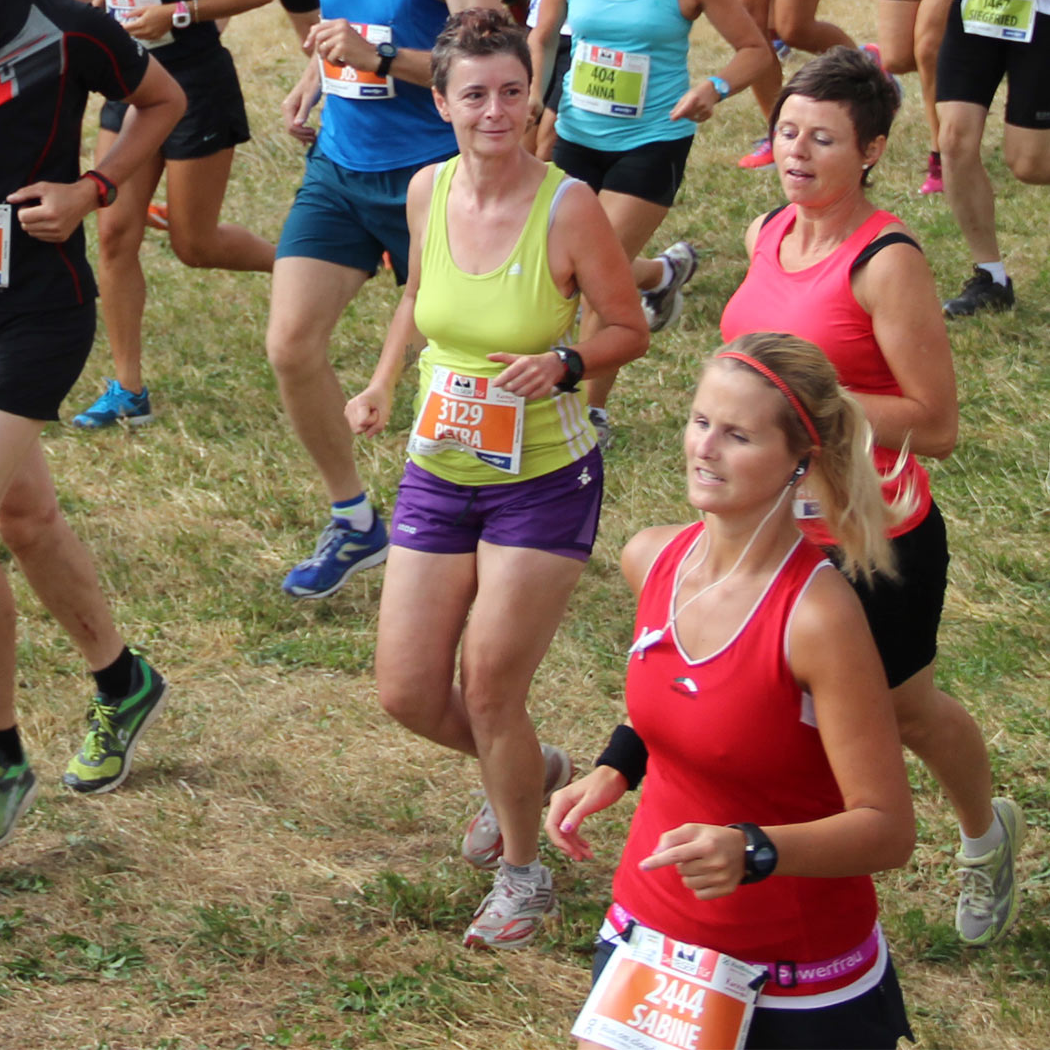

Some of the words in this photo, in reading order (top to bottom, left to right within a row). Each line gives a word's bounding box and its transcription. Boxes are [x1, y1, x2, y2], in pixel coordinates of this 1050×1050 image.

[968, 8, 1019, 28] SIEGFRIED
[590, 66, 616, 84] 404
[585, 82, 616, 101] ANNA
[437, 397, 484, 426] 3129
[433, 422, 483, 449] PETRA
[778, 950, 863, 980] Pwerfrau
[643, 973, 704, 1018] 2444
[626, 1003, 702, 1050] SABINE
